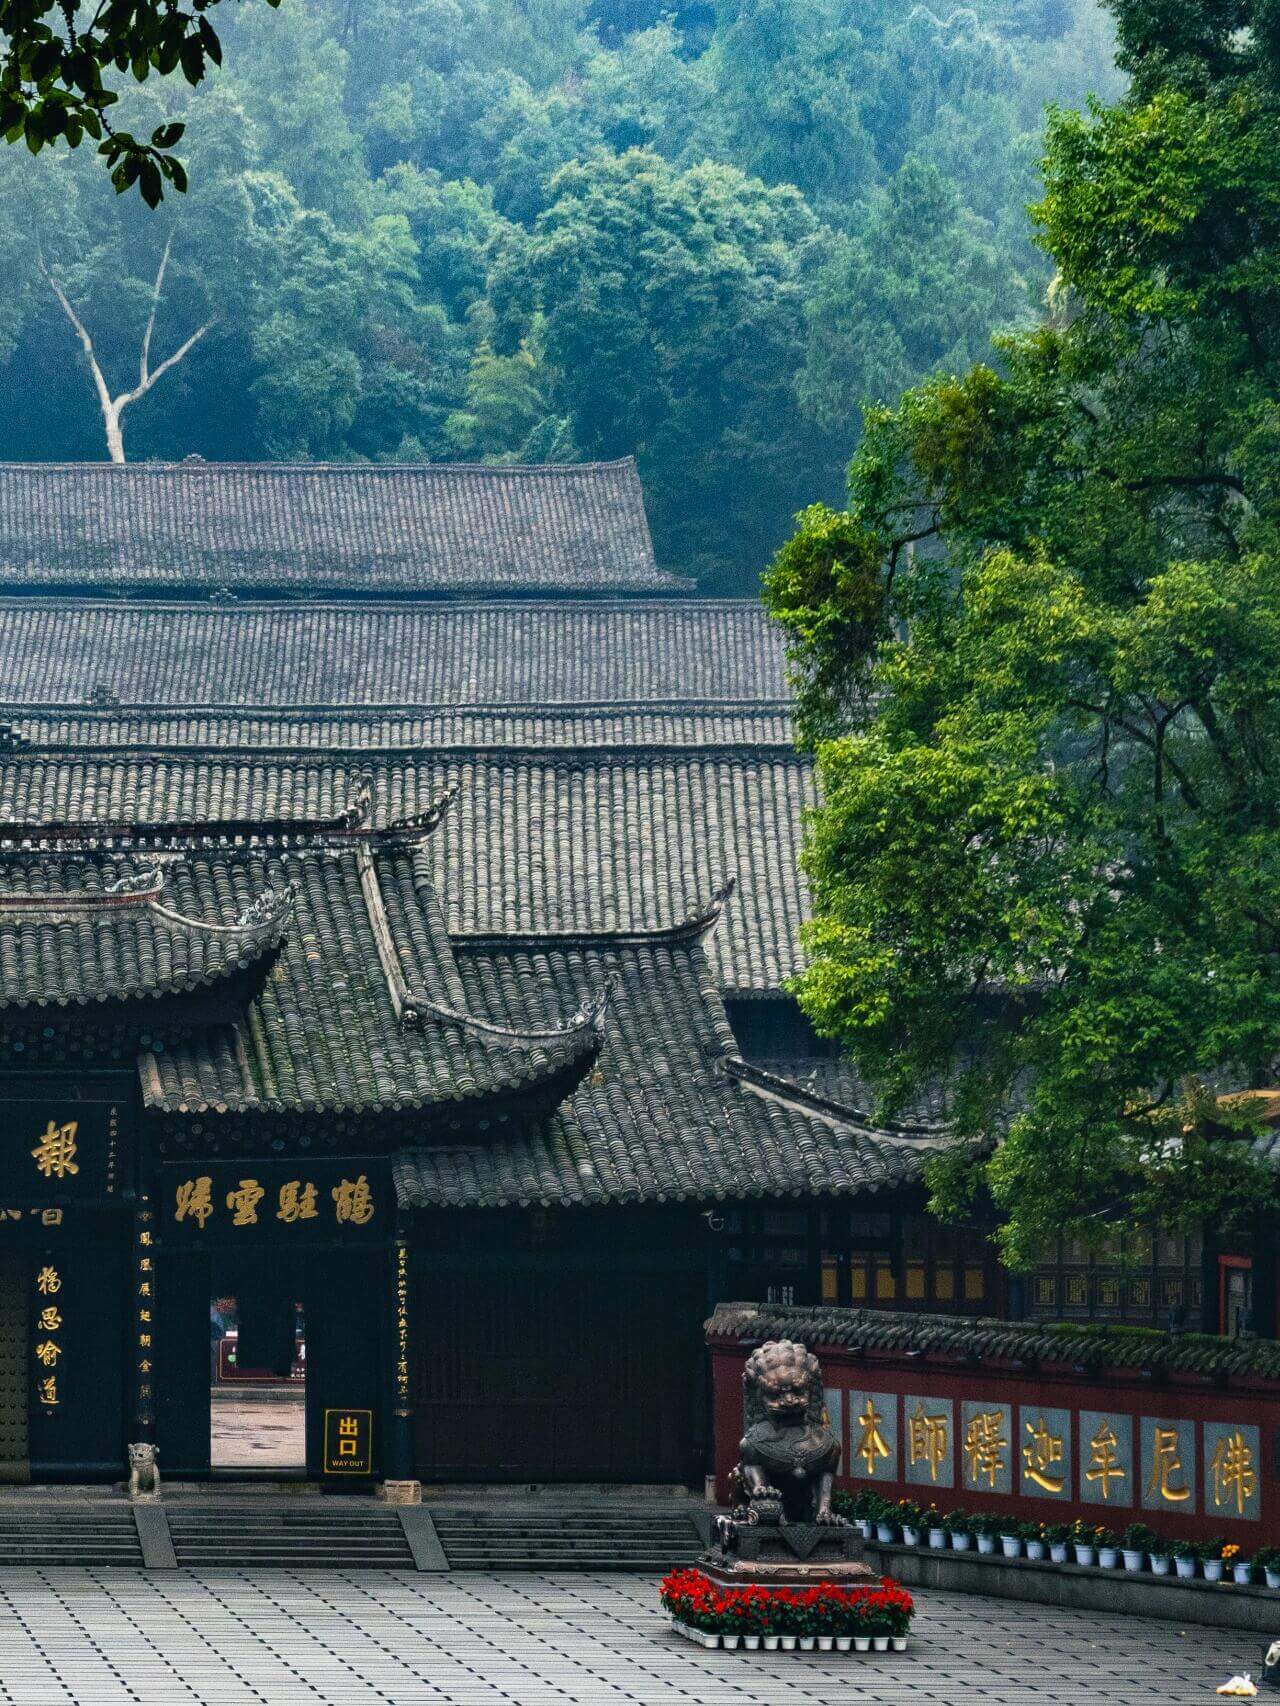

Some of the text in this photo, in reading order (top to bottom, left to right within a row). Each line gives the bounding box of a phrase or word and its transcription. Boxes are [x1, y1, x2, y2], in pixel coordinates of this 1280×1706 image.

[338, 1416, 359, 1456] 出口
[331, 1459, 364, 1467] WAY OUT
[822, 1398, 1256, 1515] 本師釋迦牟尼佛
